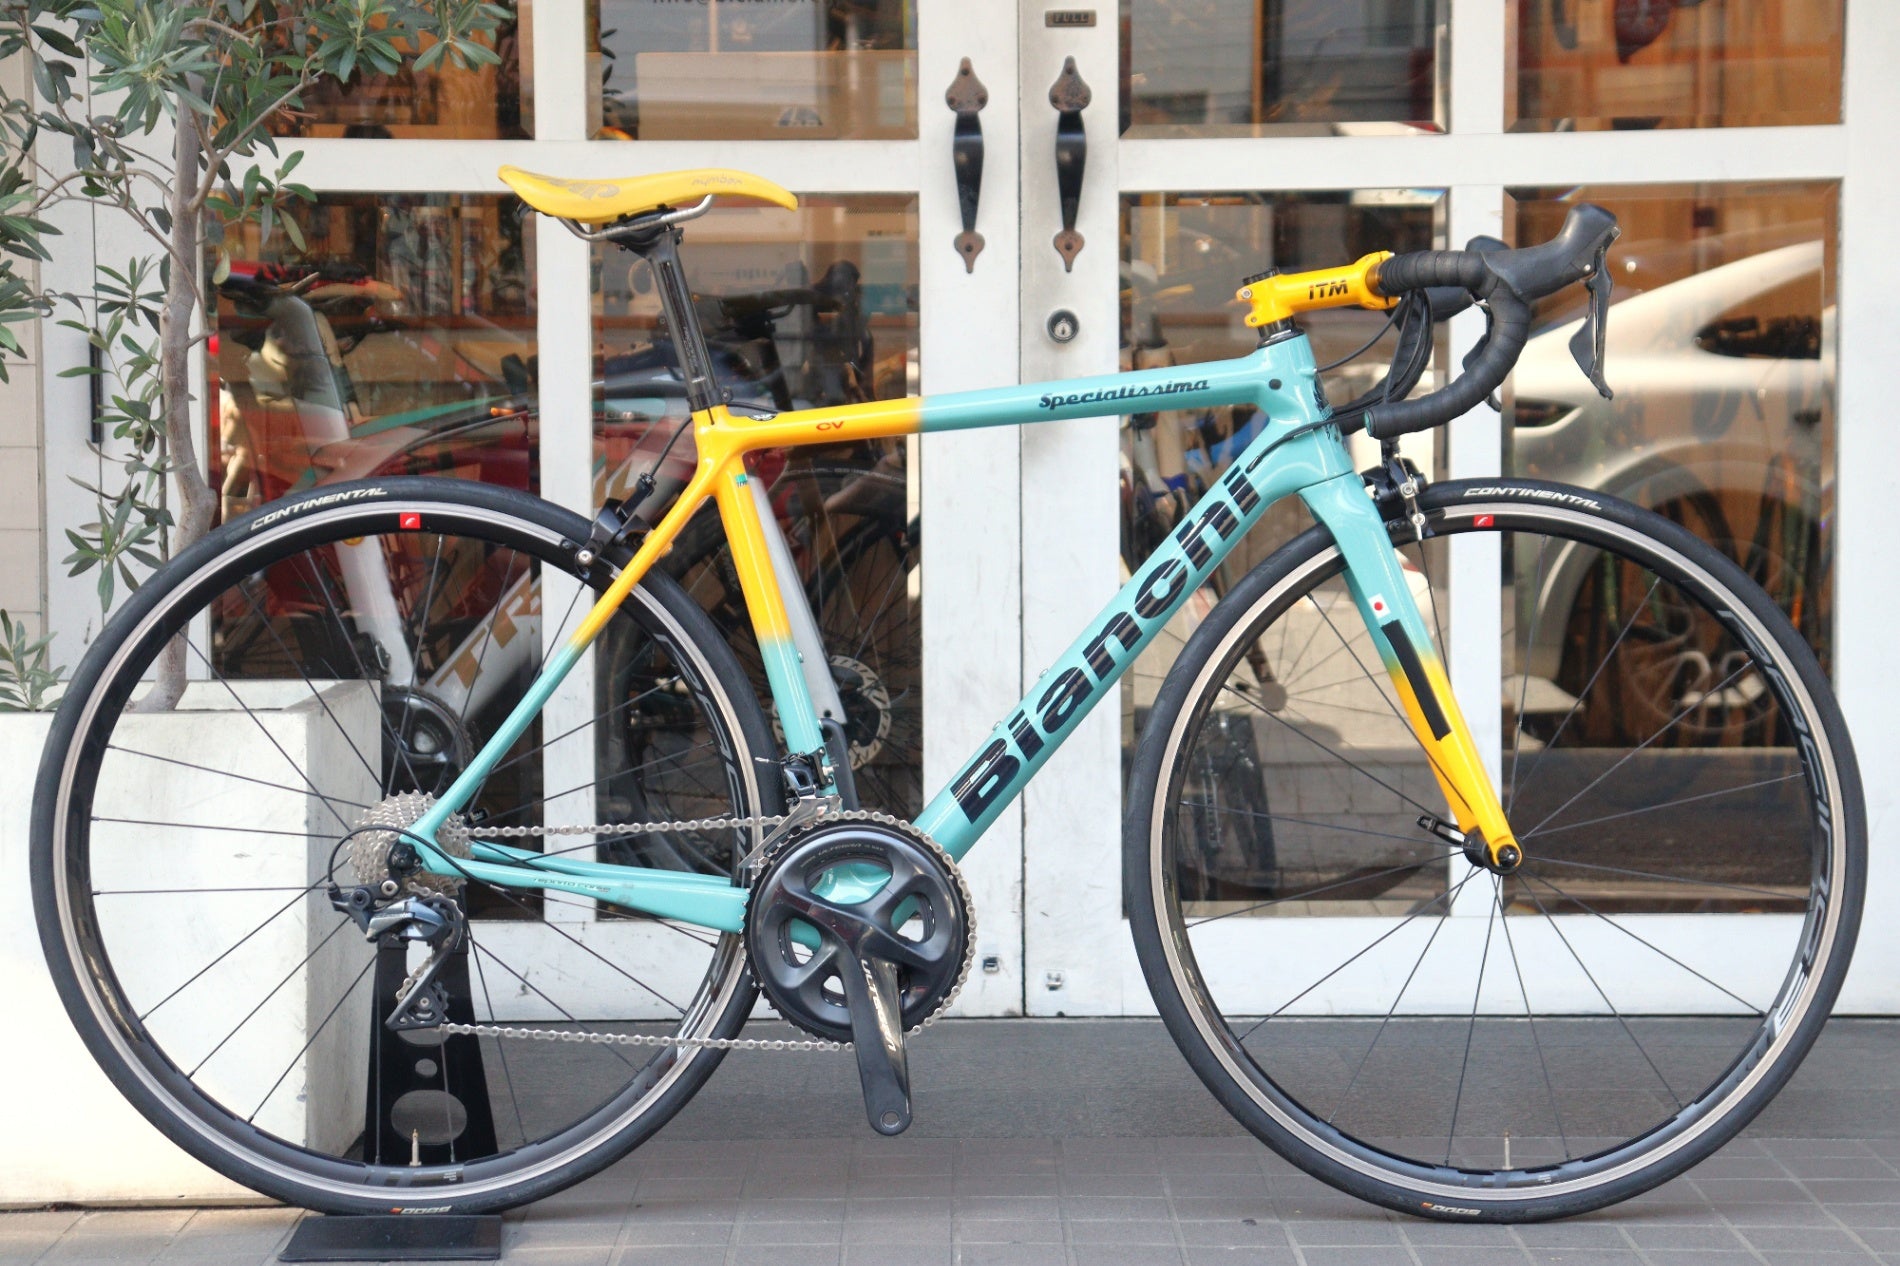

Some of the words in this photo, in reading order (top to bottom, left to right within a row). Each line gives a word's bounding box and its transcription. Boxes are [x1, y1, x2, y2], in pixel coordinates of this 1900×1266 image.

[1039, 379, 1210, 410] Specialissima
[250, 487, 388, 531] CONTINENTAL
[1463, 486, 1602, 510] CONTINENTAL
[950, 465, 1262, 824] Bianchi
